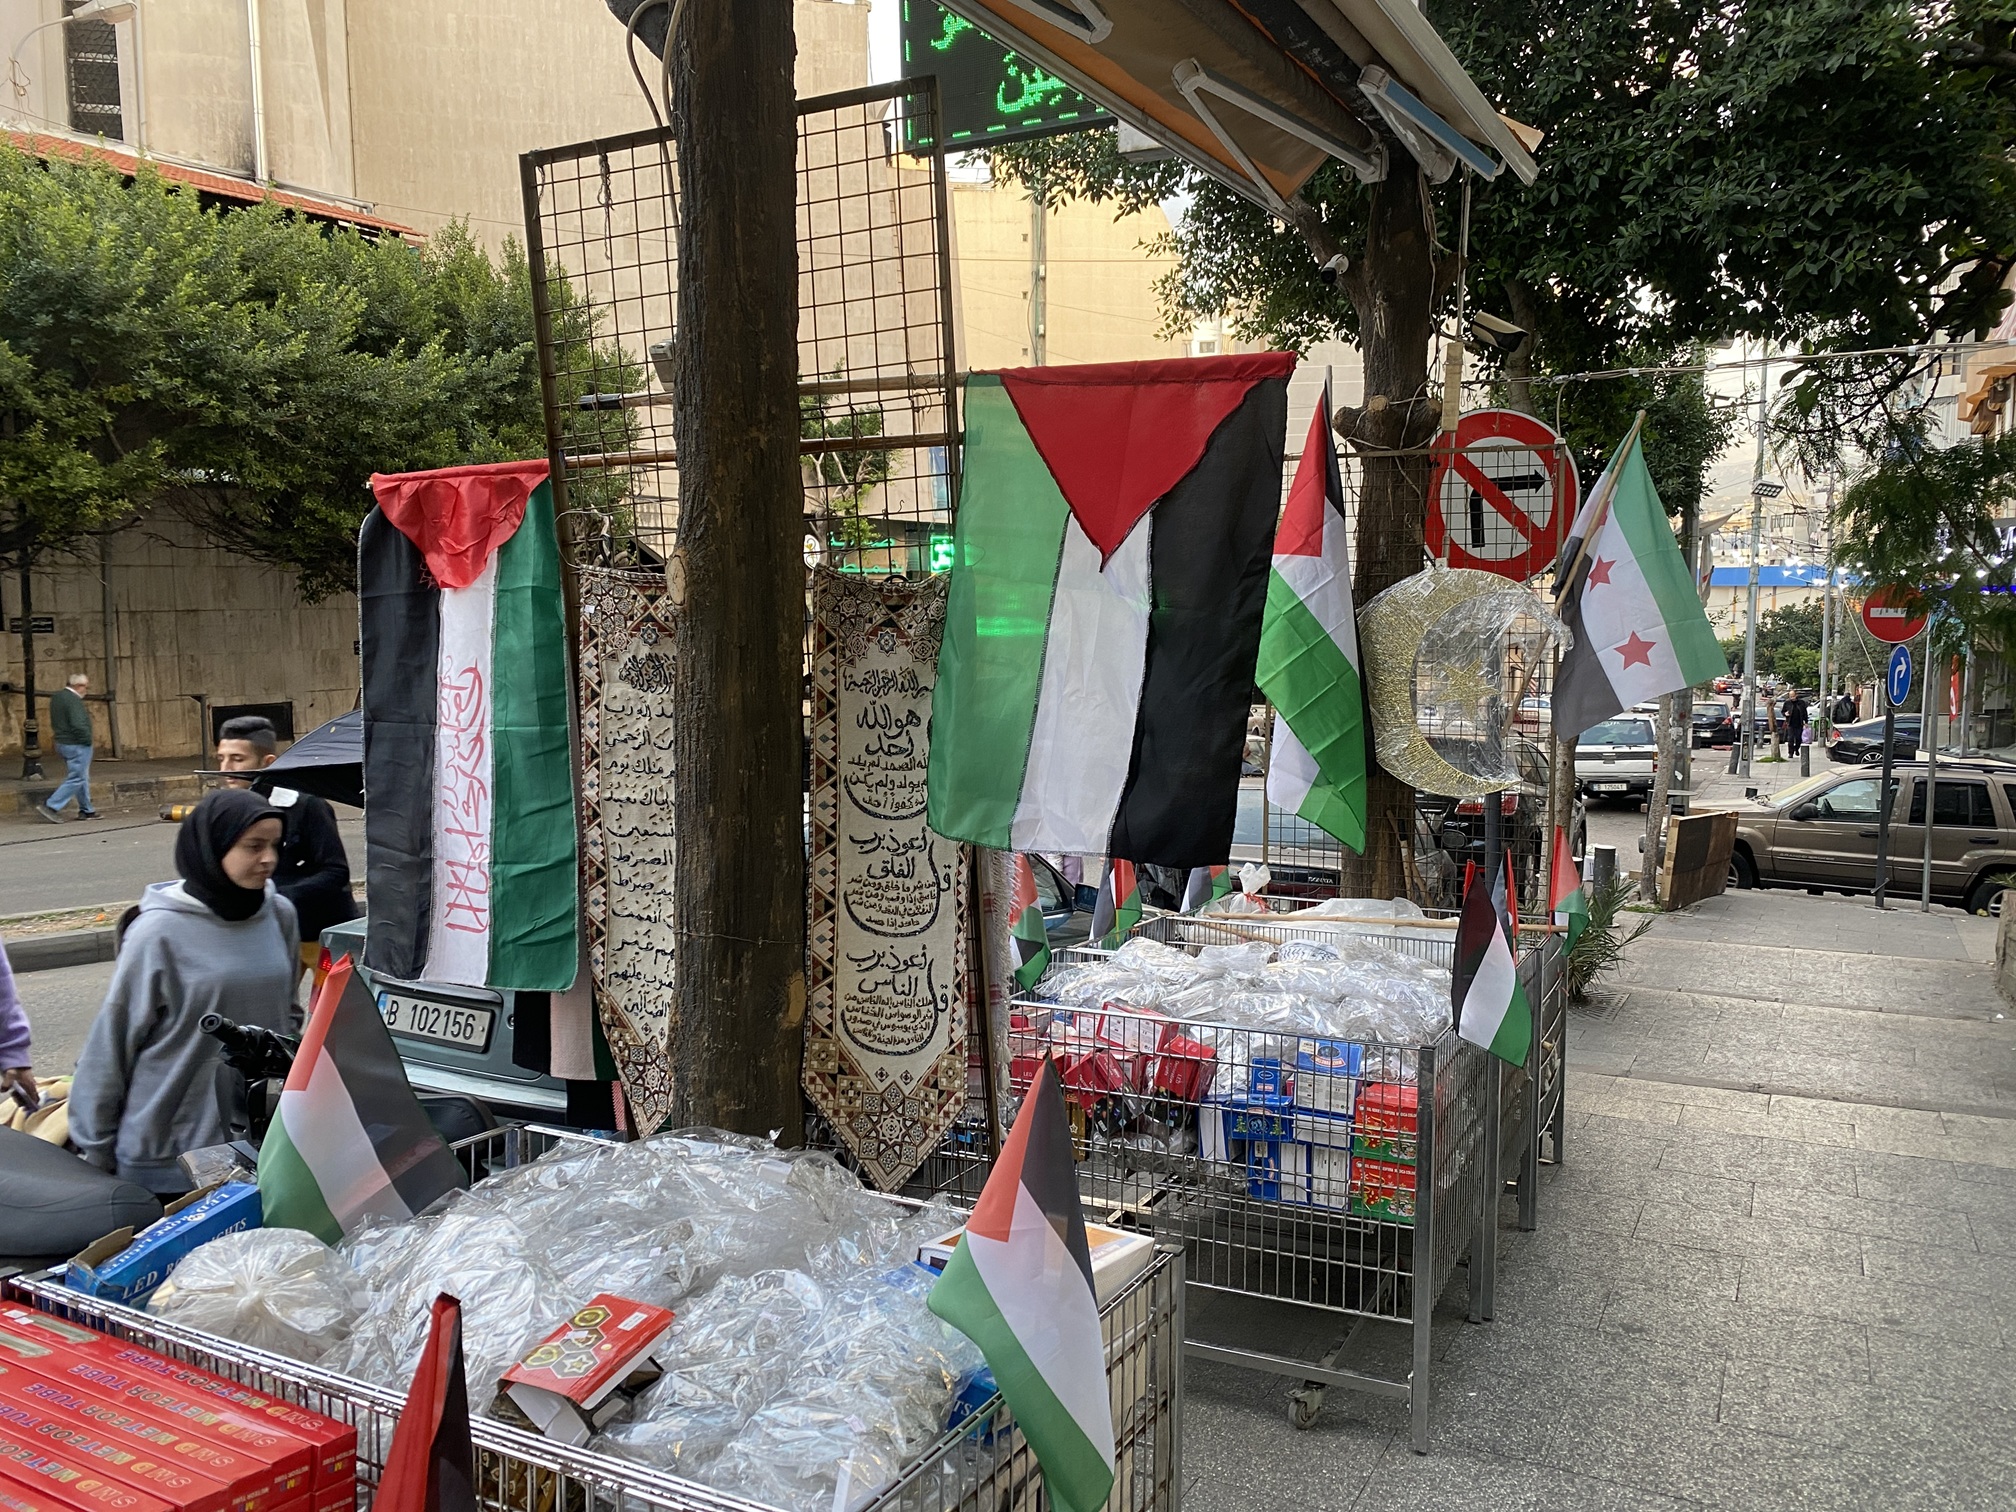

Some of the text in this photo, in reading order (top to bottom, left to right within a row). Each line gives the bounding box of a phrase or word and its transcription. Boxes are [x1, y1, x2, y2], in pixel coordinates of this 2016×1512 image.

[387, 1000, 476, 1040] B 102156
[122, 1270, 158, 1299] LED
[21, 1383, 234, 1467] SMD METEOR TUBE
[67, 1363, 277, 1447] SMD METEOR TUBE
[115, 1349, 324, 1430] SMD METEOR TUBE
[0, 1401, 192, 1488] SMD METEOR TUB
[76, 1479, 137, 1507] SMD
